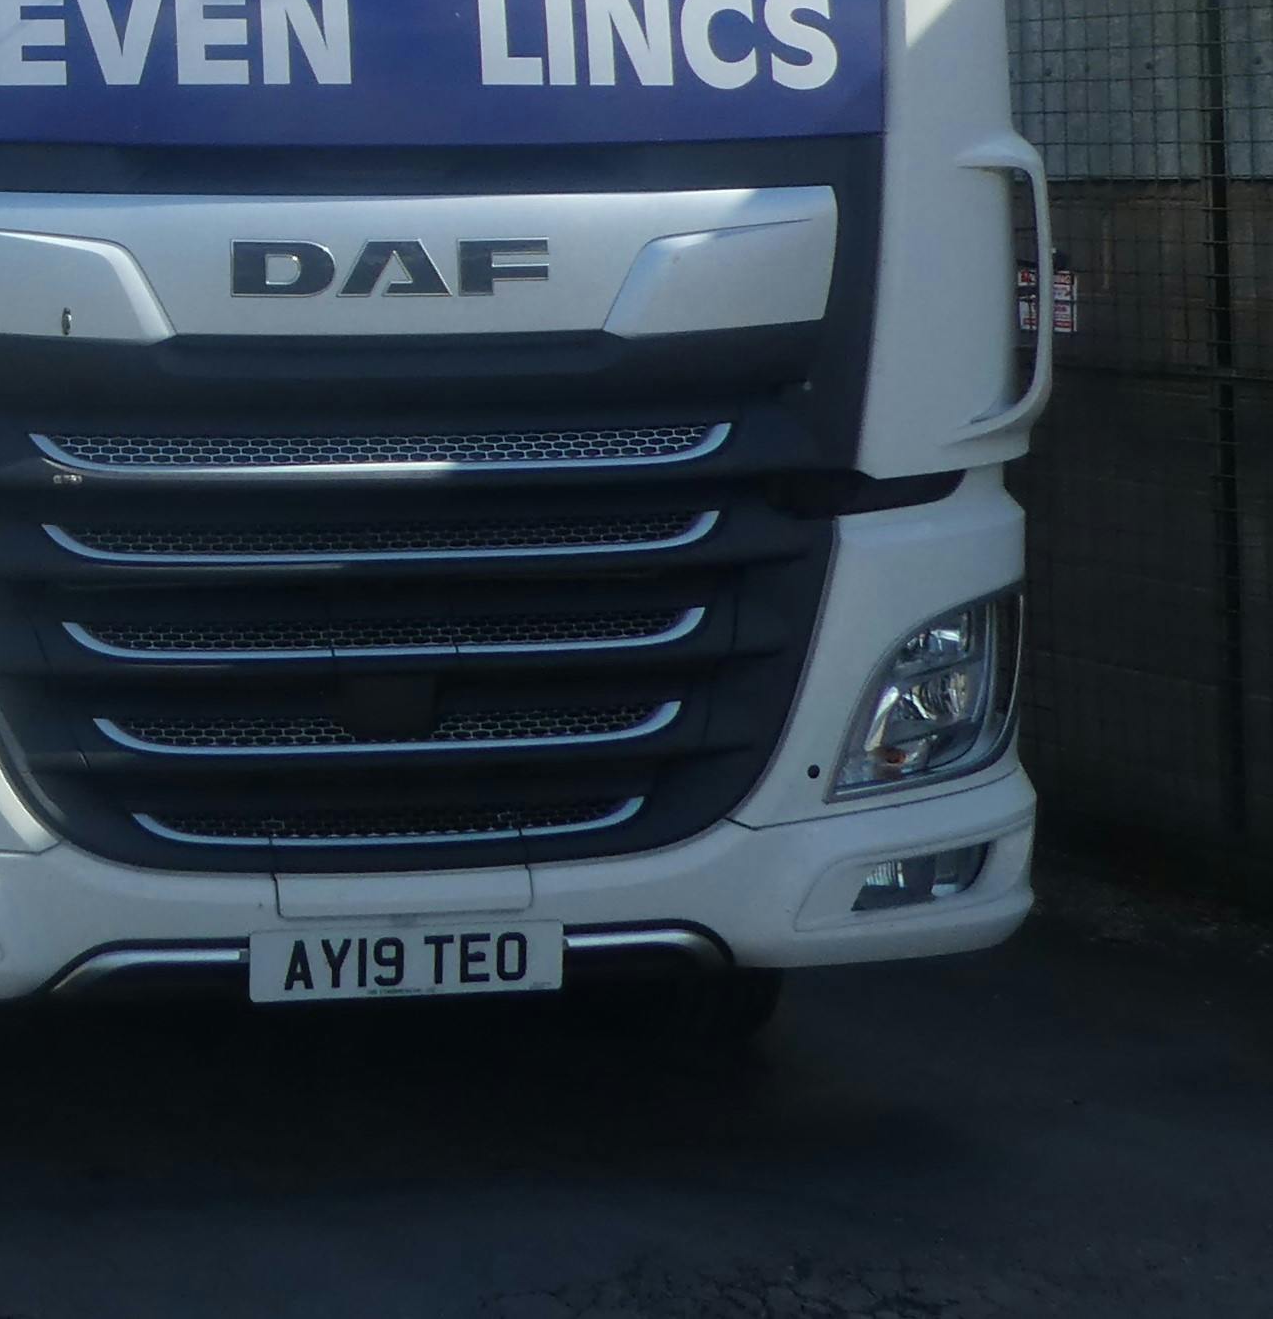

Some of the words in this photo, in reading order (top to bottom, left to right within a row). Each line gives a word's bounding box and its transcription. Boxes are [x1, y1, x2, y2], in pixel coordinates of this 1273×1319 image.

[229, 236, 551, 299] DAF
[283, 936, 404, 991] AY19
[423, 932, 528, 985] TEO
